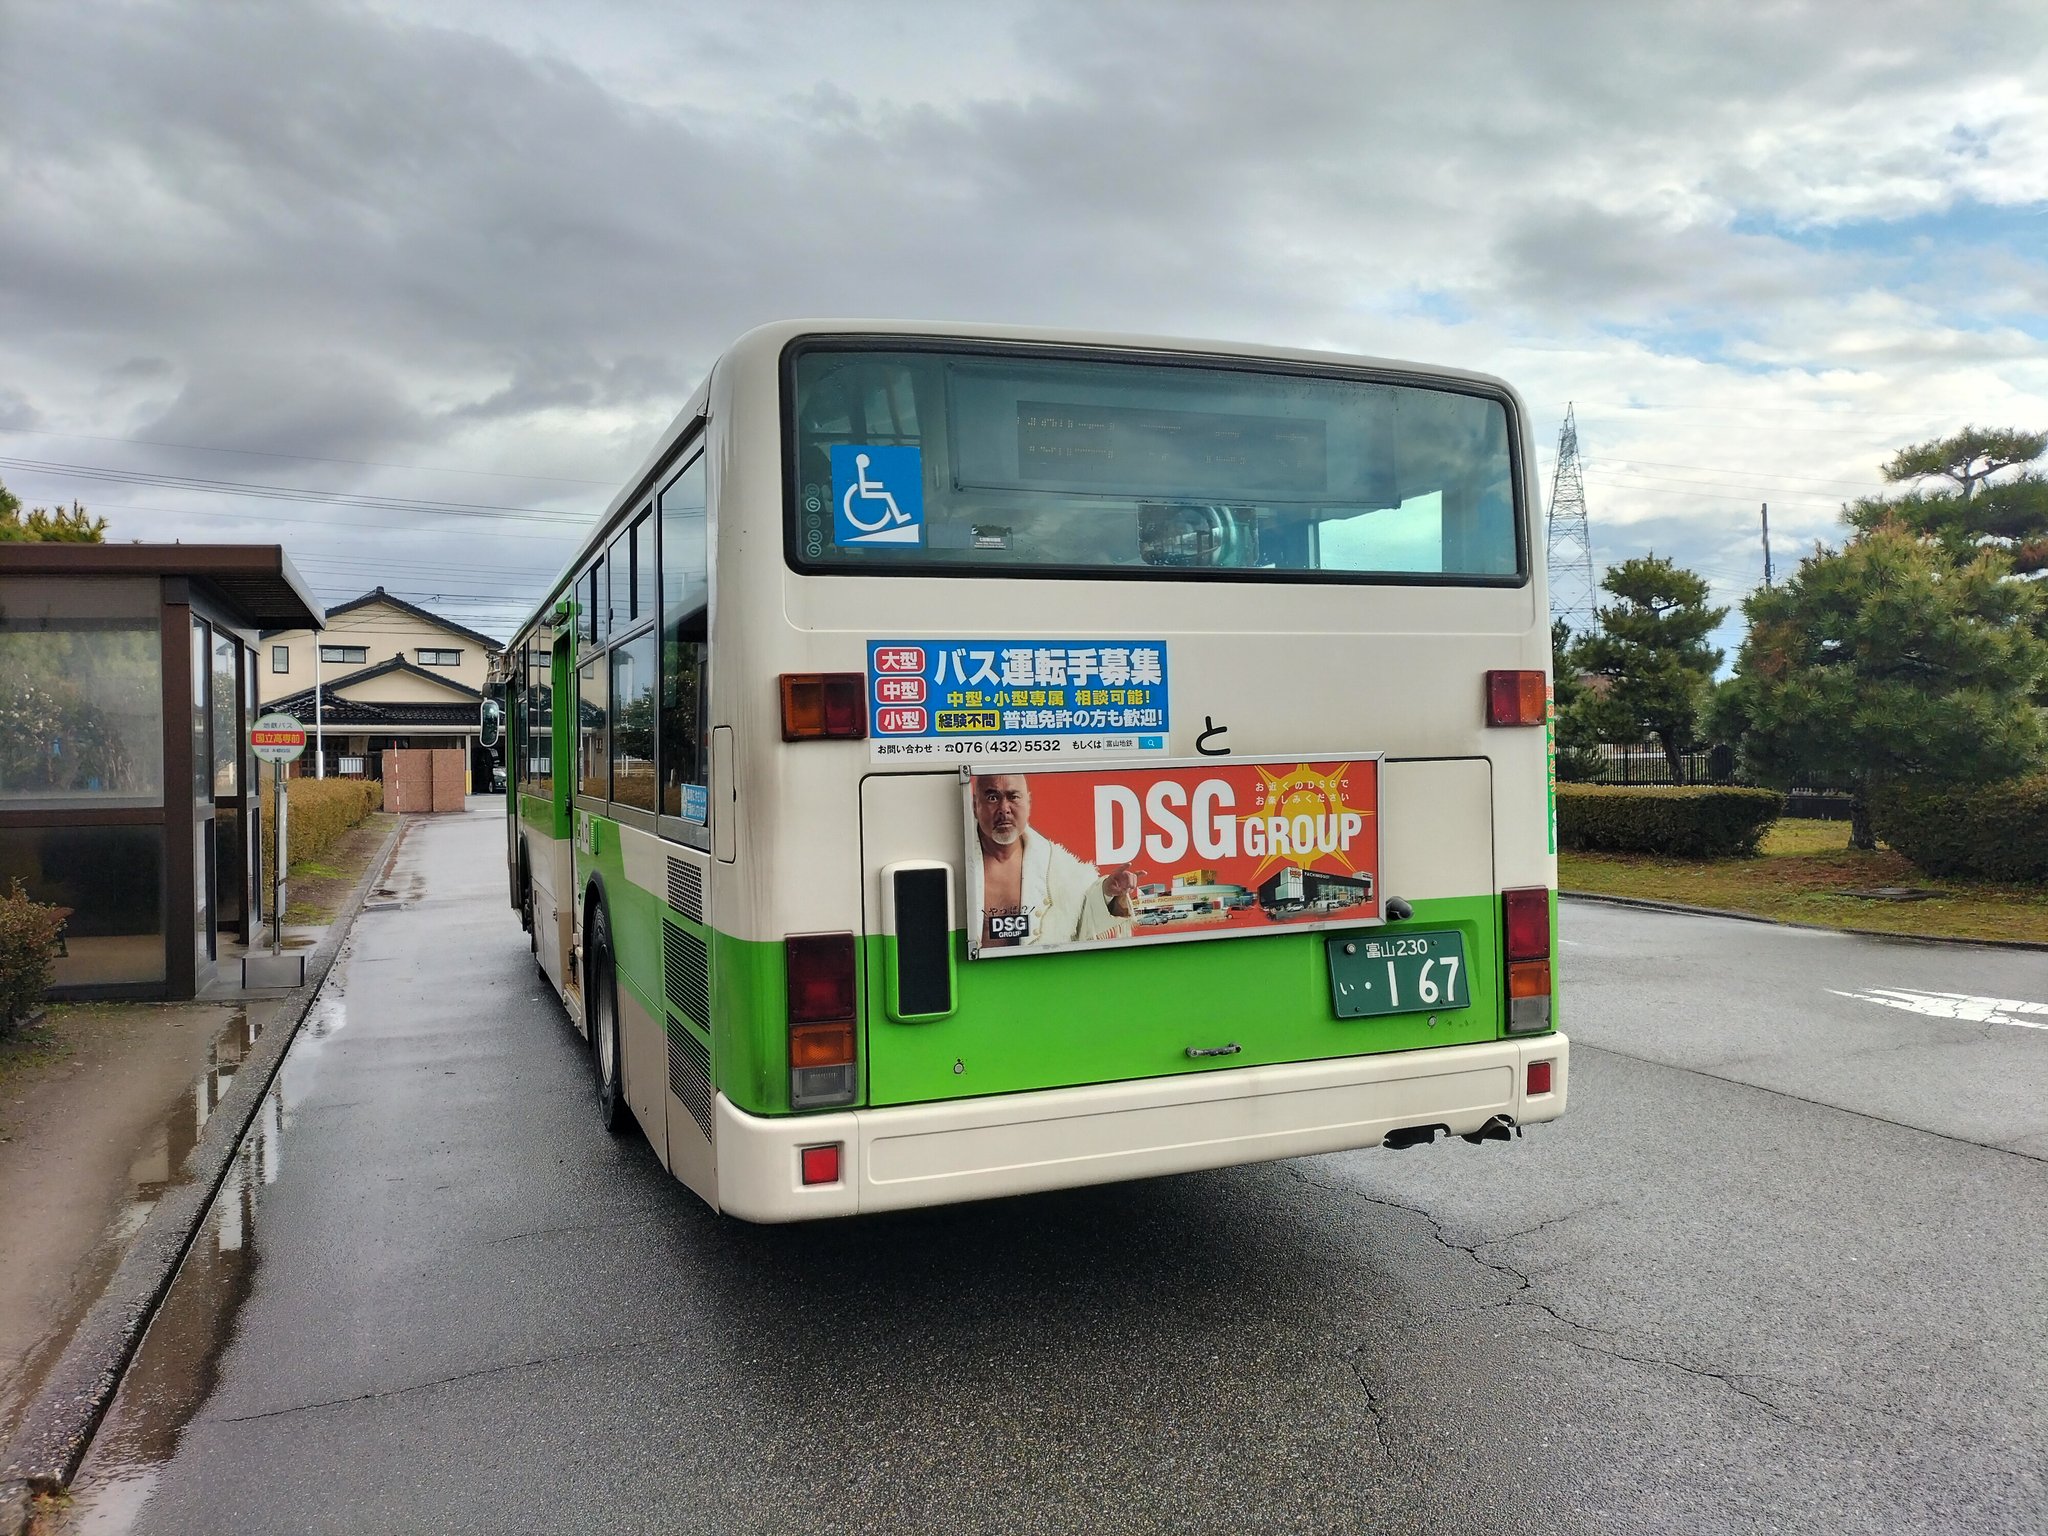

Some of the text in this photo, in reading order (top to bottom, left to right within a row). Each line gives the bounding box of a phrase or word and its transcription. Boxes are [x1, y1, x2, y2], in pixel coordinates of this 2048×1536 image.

[881, 651, 918, 670] 大型
[933, 648, 1162, 687] バス運転手募集
[883, 681, 919, 700] 中型
[946, 689, 1150, 707] 中型・小型専属 相談可能!
[883, 711, 920, 730] 小型
[938, 709, 1163, 730] 経験不問 普通免許の方も歓迎!
[255, 733, 300, 744] 国立高専前
[1072, 740, 1102, 750] もしくは
[1105, 739, 1133, 748] 富山地鉄
[1196, 716, 1231, 756] と
[1093, 778, 1362, 866] DSG GROUP
[992, 916, 1027, 932] DSG
